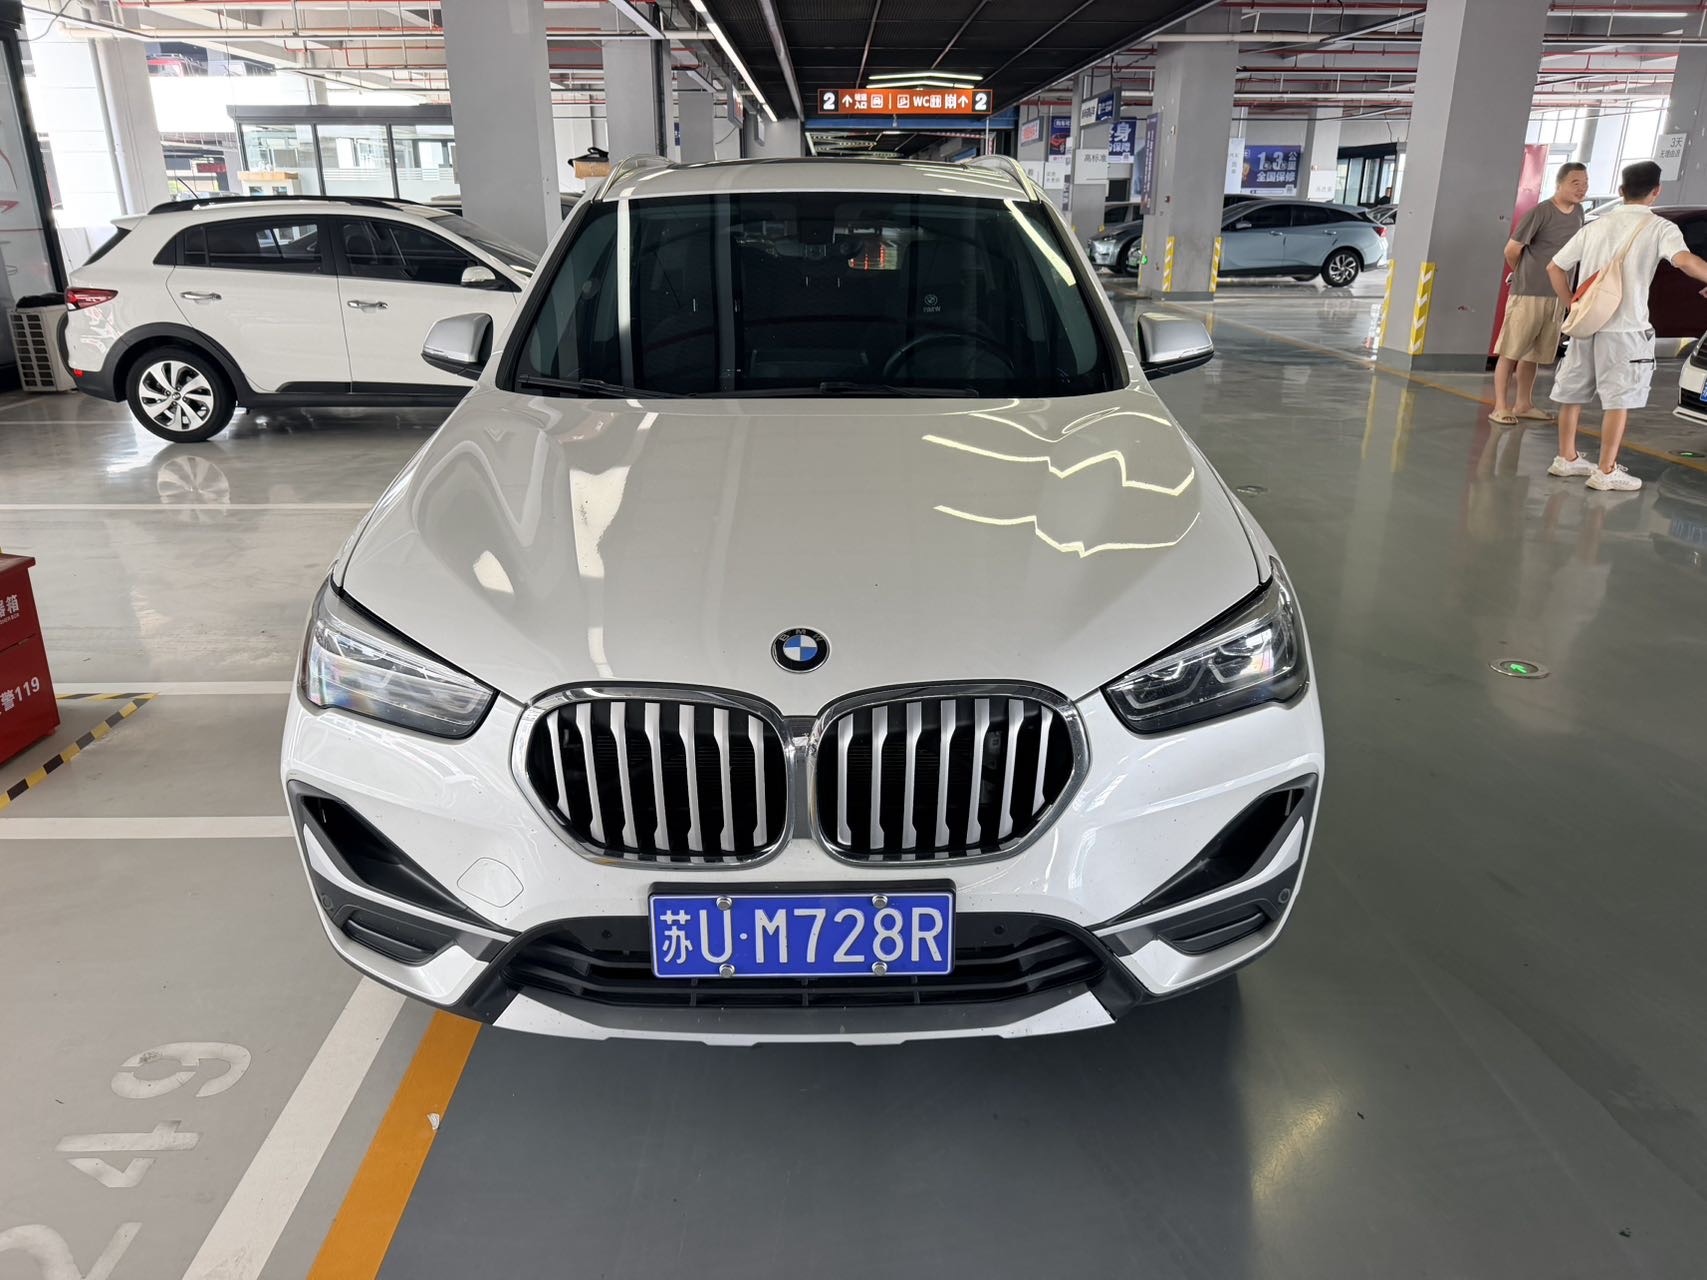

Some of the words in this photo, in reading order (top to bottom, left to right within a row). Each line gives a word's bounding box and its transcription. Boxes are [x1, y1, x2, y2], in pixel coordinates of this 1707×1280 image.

[823, 92, 835, 110] 2
[912, 95, 930, 107] WC
[974, 92, 988, 110] 2
[0, 676, 40, 714] 警119
[659, 907, 944, 965] 苏U·M728R
